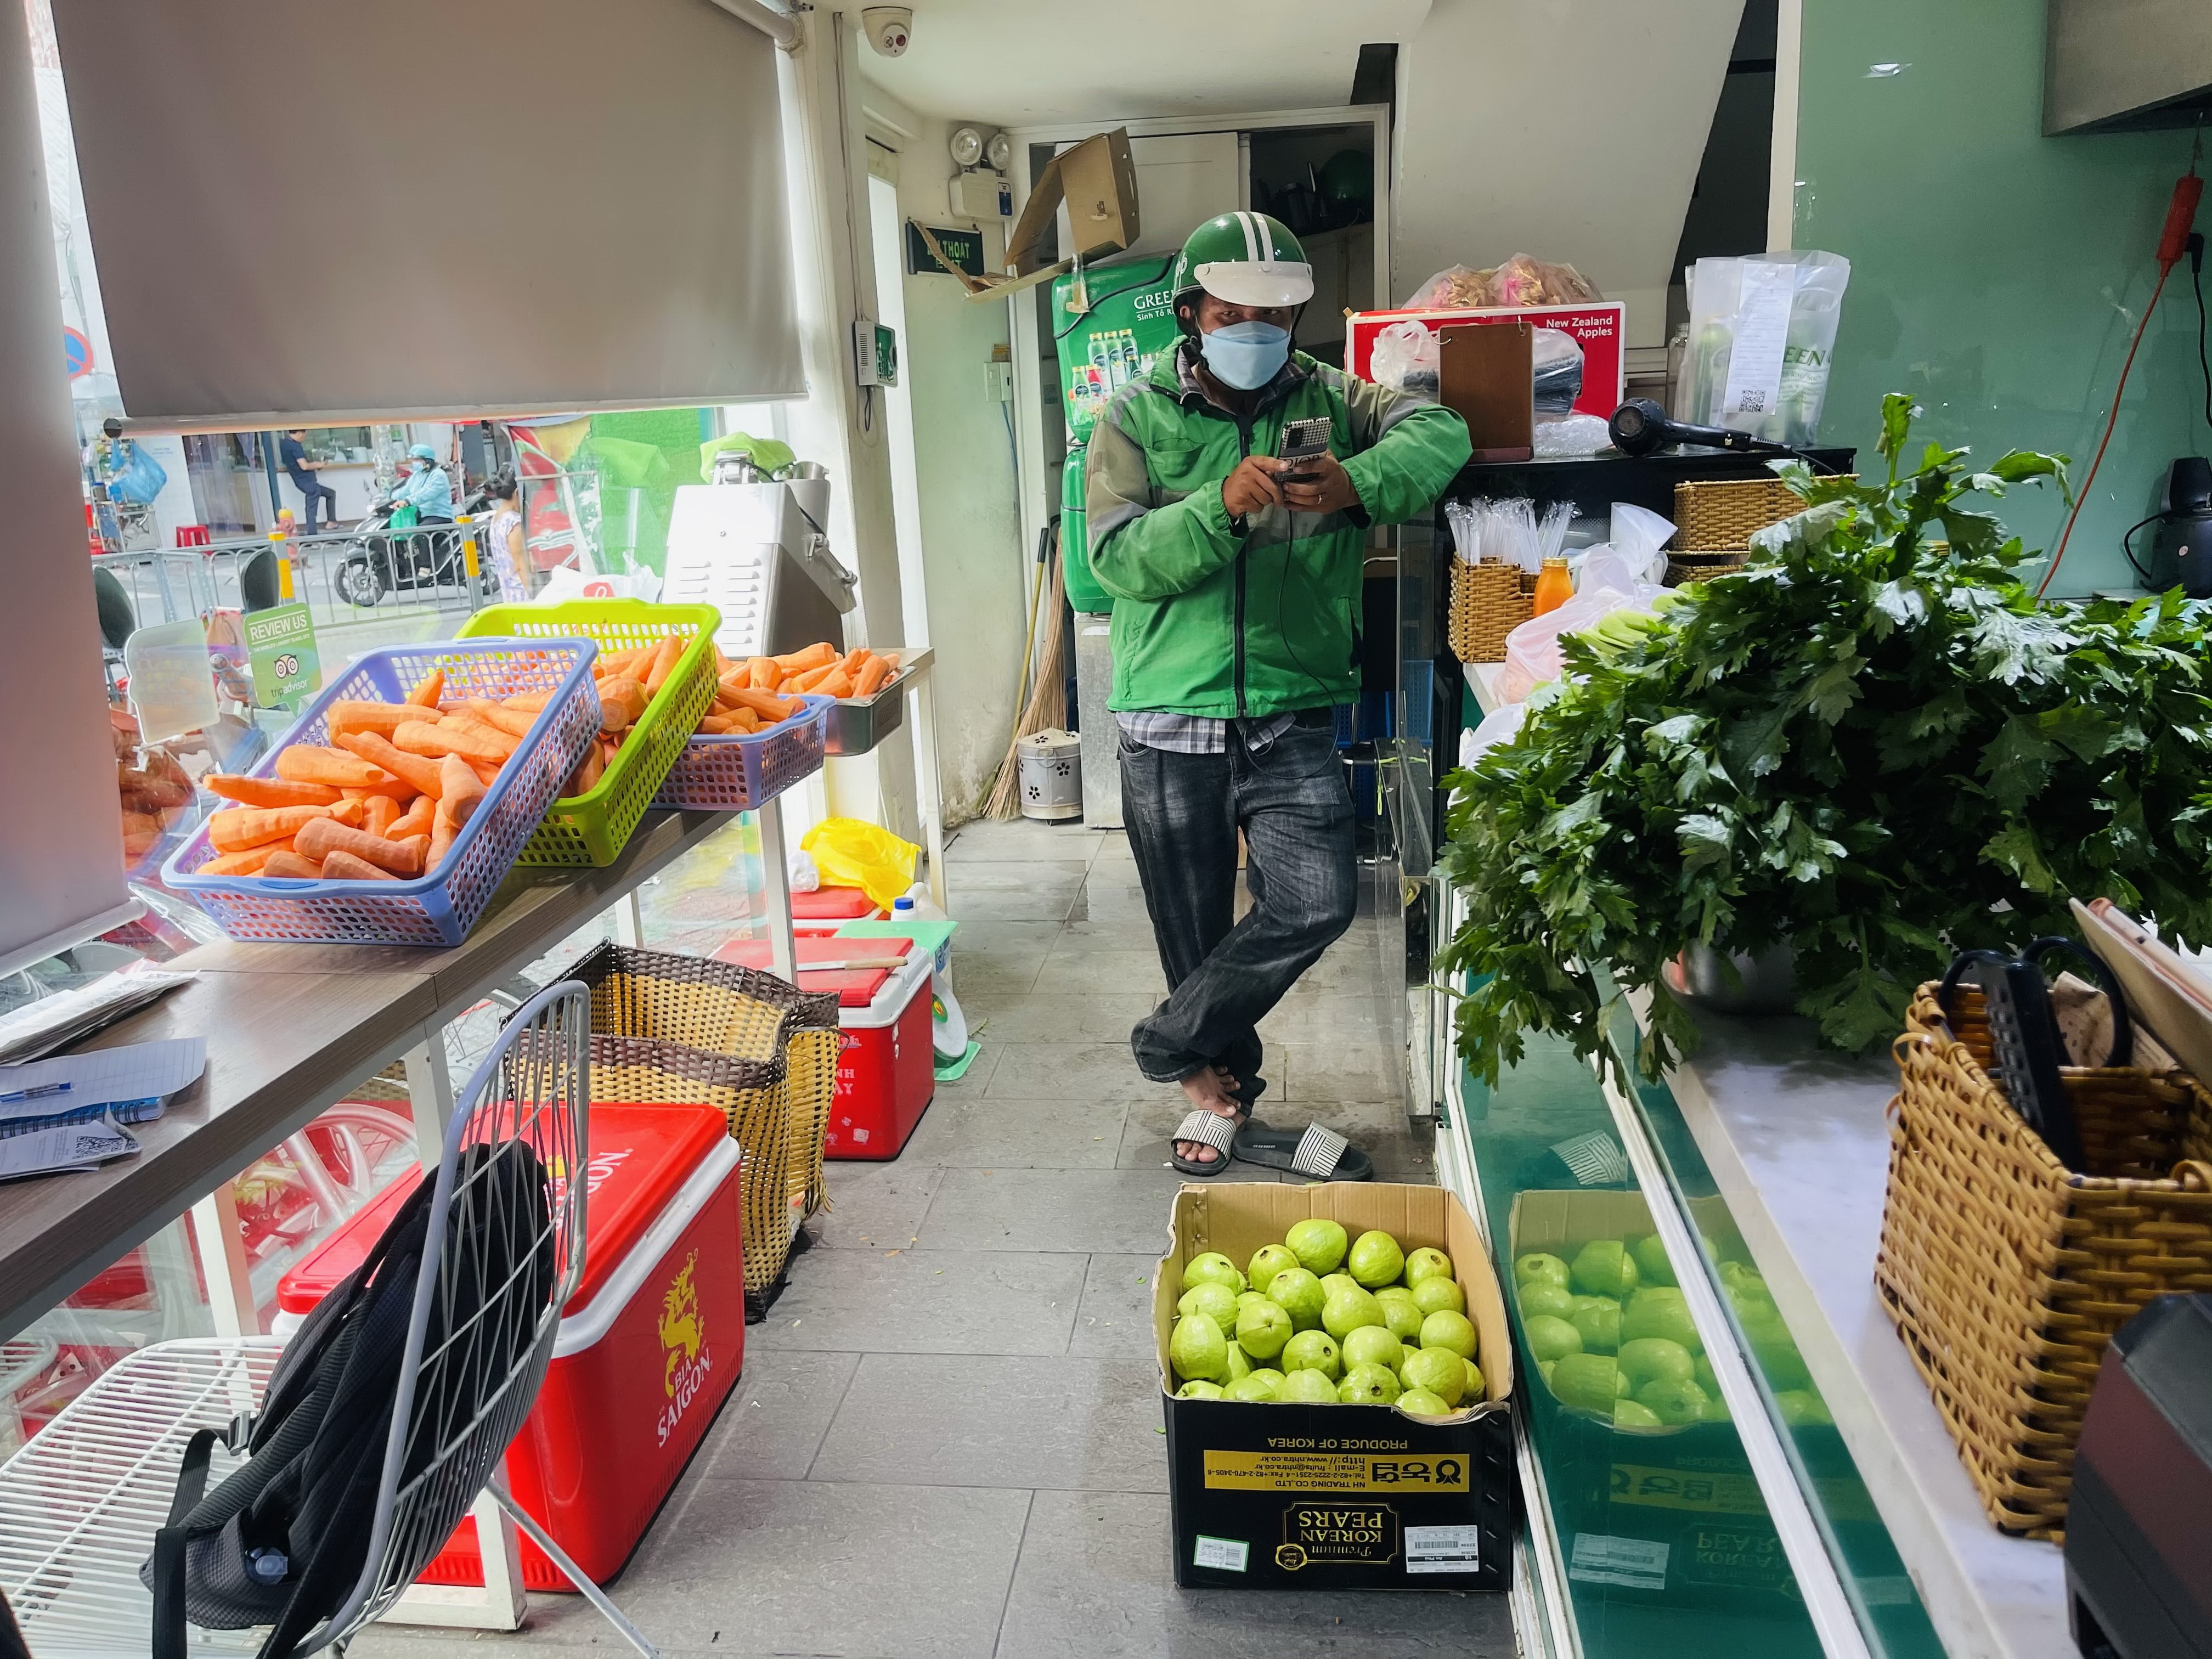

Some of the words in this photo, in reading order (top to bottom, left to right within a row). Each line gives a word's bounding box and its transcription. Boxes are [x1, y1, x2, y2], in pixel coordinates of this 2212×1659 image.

[943, 239, 969, 259] THOÁT
[1137, 313, 1153, 321] Sinh
[1155, 308, 1164, 318] Tố
[1546, 319, 1569, 328] New
[1572, 315, 1613, 327] Zealand
[1577, 327, 1612, 339] Apples
[250, 618, 291, 641] REVIEW
[292, 614, 307, 629] US
[271, 679, 308, 698] tripadvisor
[675, 1358, 692, 1392] BIA
[657, 1347, 710, 1448] SAIGON
[1267, 1437, 1315, 1448] KOREA
[1318, 1438, 1338, 1448] OF
[1341, 1439, 1408, 1449] PRODUCE
[1329, 1455, 1365, 1465] http://
[1372, 1462, 1431, 1483] 농협
[1298, 1510, 1383, 1528] PEARS
[1300, 1530, 1383, 1543] KOREAN
[1312, 1545, 1372, 1557] Premium
